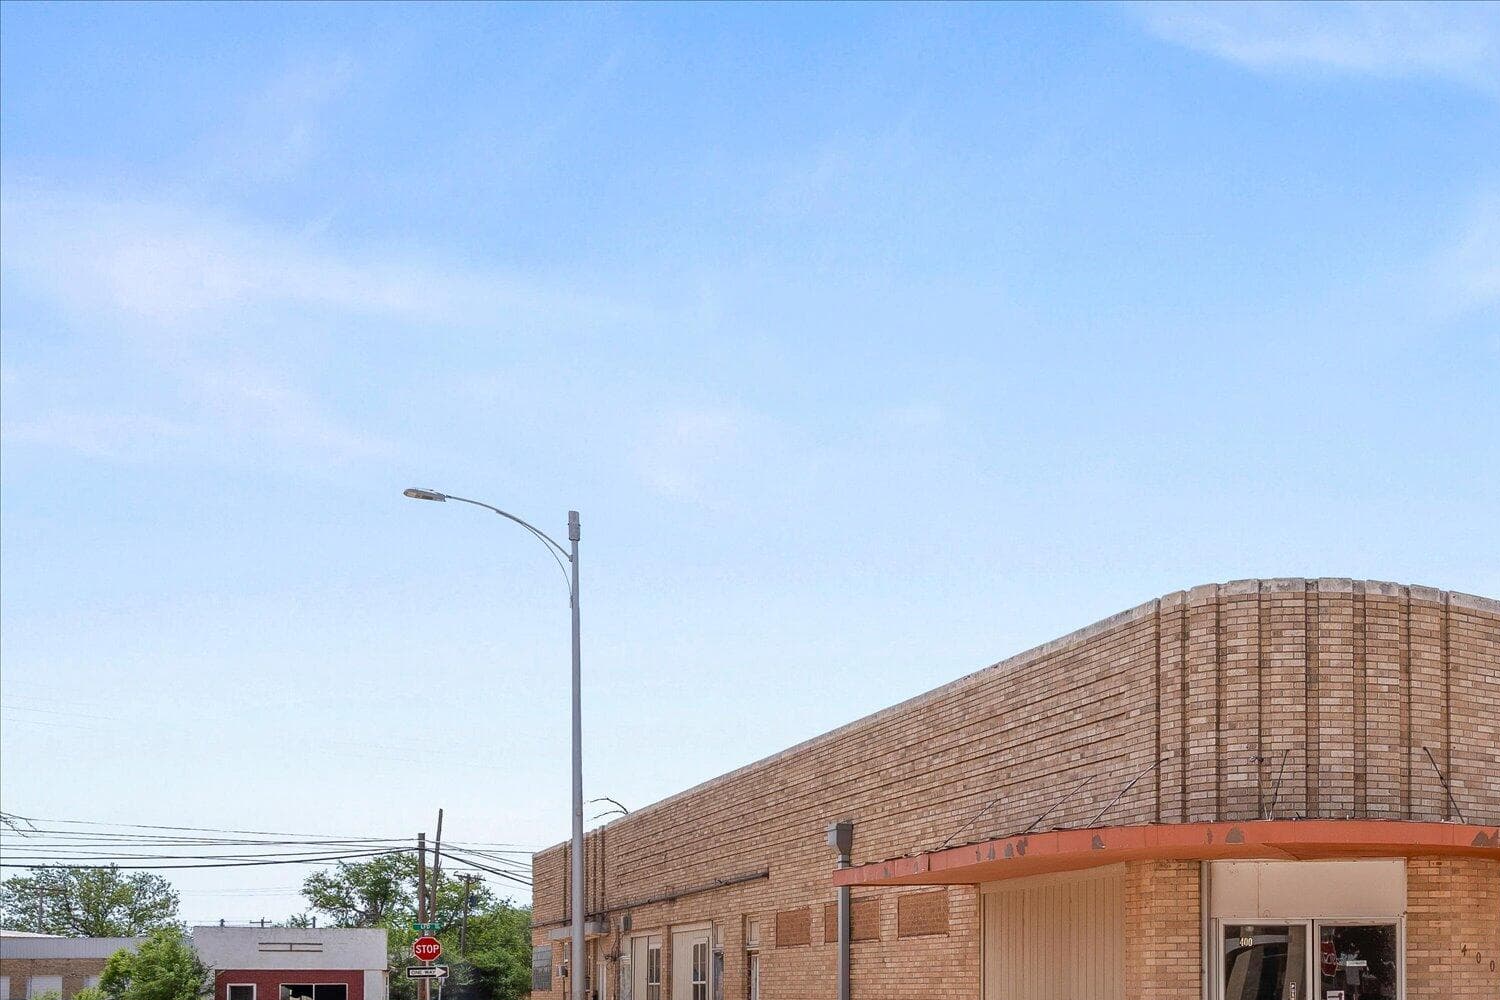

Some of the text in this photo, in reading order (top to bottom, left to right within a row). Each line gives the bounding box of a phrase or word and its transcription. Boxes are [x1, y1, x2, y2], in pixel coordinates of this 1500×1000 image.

[1240, 937, 1253, 947] 400
[415, 944, 440, 953] STOP
[1461, 944, 1495, 972] 400
